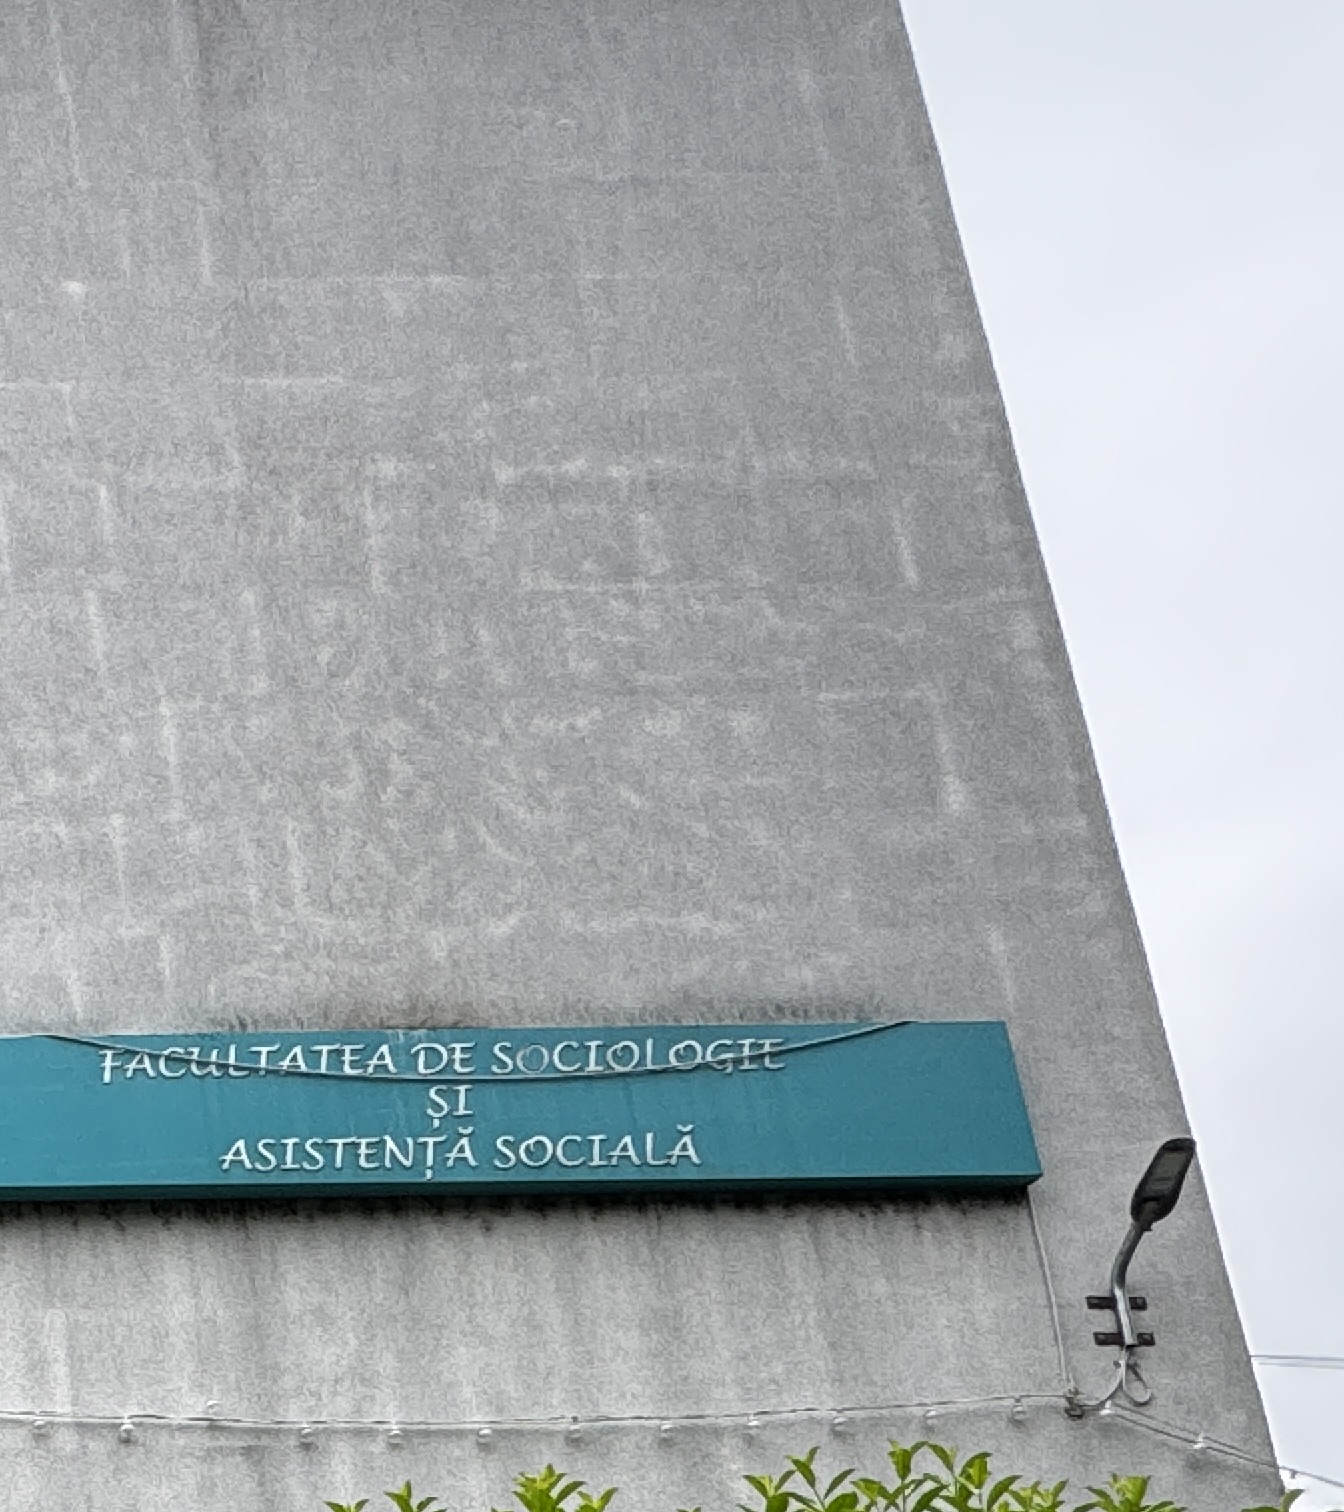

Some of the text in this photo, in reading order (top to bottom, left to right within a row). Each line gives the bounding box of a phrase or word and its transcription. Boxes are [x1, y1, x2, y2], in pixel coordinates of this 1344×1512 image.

[99, 1037, 786, 1084] FACULTATEA DE SOCIOLOGIE
[426, 1085, 474, 1129] ȘI
[218, 1124, 702, 1180] ASISTENȚĂ SOCIALĂ
